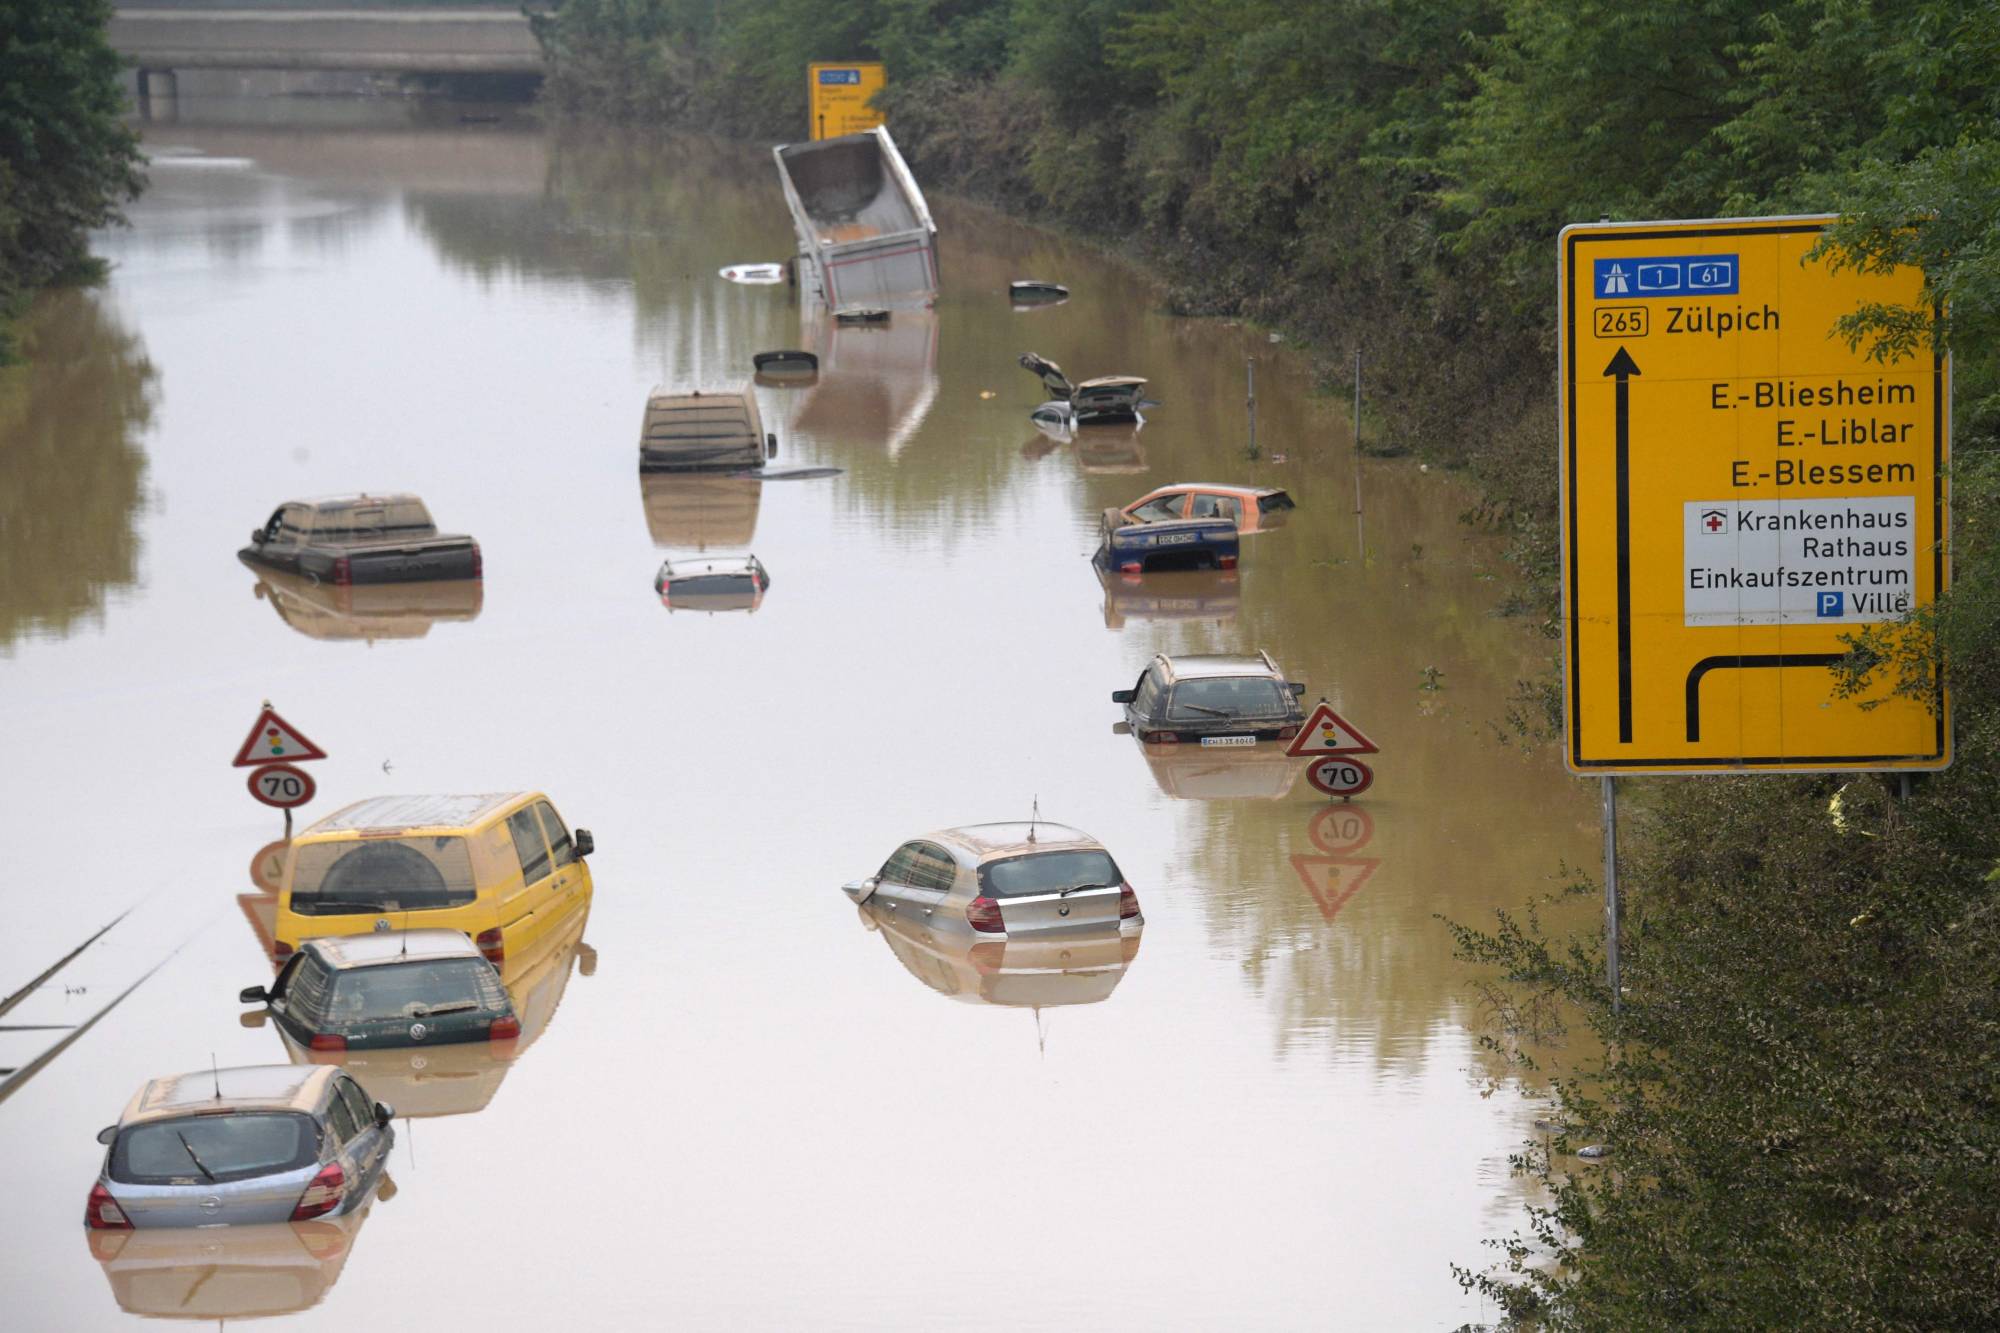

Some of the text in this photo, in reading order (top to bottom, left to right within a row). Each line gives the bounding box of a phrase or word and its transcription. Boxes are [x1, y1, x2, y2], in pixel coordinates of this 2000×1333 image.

[1656, 267, 1719, 285] 1 61
[1601, 305, 1779, 338] 265 Zülpich
[1711, 379, 1914, 409] E.-Bliesheim
[1777, 419, 1913, 446] E.-Liblar
[1732, 460, 1914, 487] E.-Blessem
[1738, 509, 1908, 531] Krankenhaus
[1803, 537, 1908, 559] Rathaus
[1690, 567, 1908, 589] Einkaufszentrum
[1822, 592, 1908, 615] P Ville
[264, 777, 301, 797] 70
[1322, 768, 1359, 786] 70
